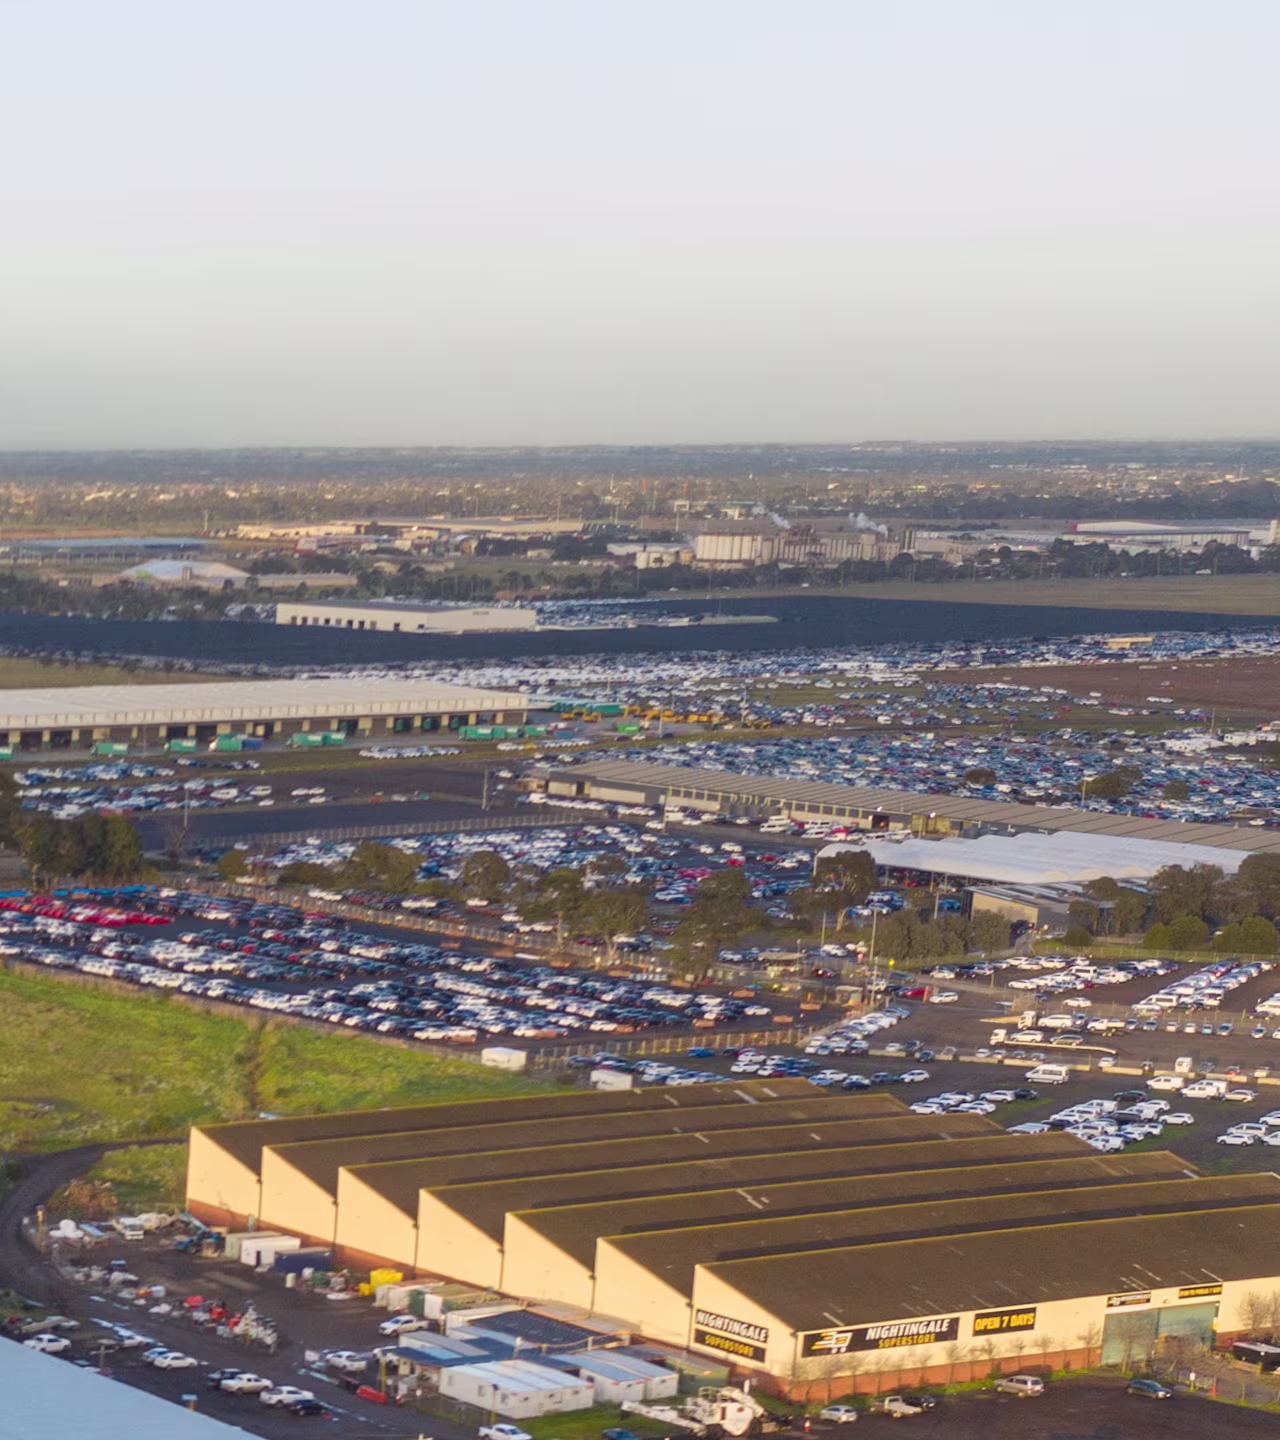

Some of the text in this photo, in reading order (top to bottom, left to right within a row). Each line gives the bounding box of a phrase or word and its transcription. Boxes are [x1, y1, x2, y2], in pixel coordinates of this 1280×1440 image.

[696, 1310, 768, 1341] NIGHTINGALE
[866, 1319, 950, 1341] NIGHTINGALE
[974, 1313, 1035, 1331] OPEN 7 DAYS
[878, 1333, 936, 1349] SUPERSTORE
